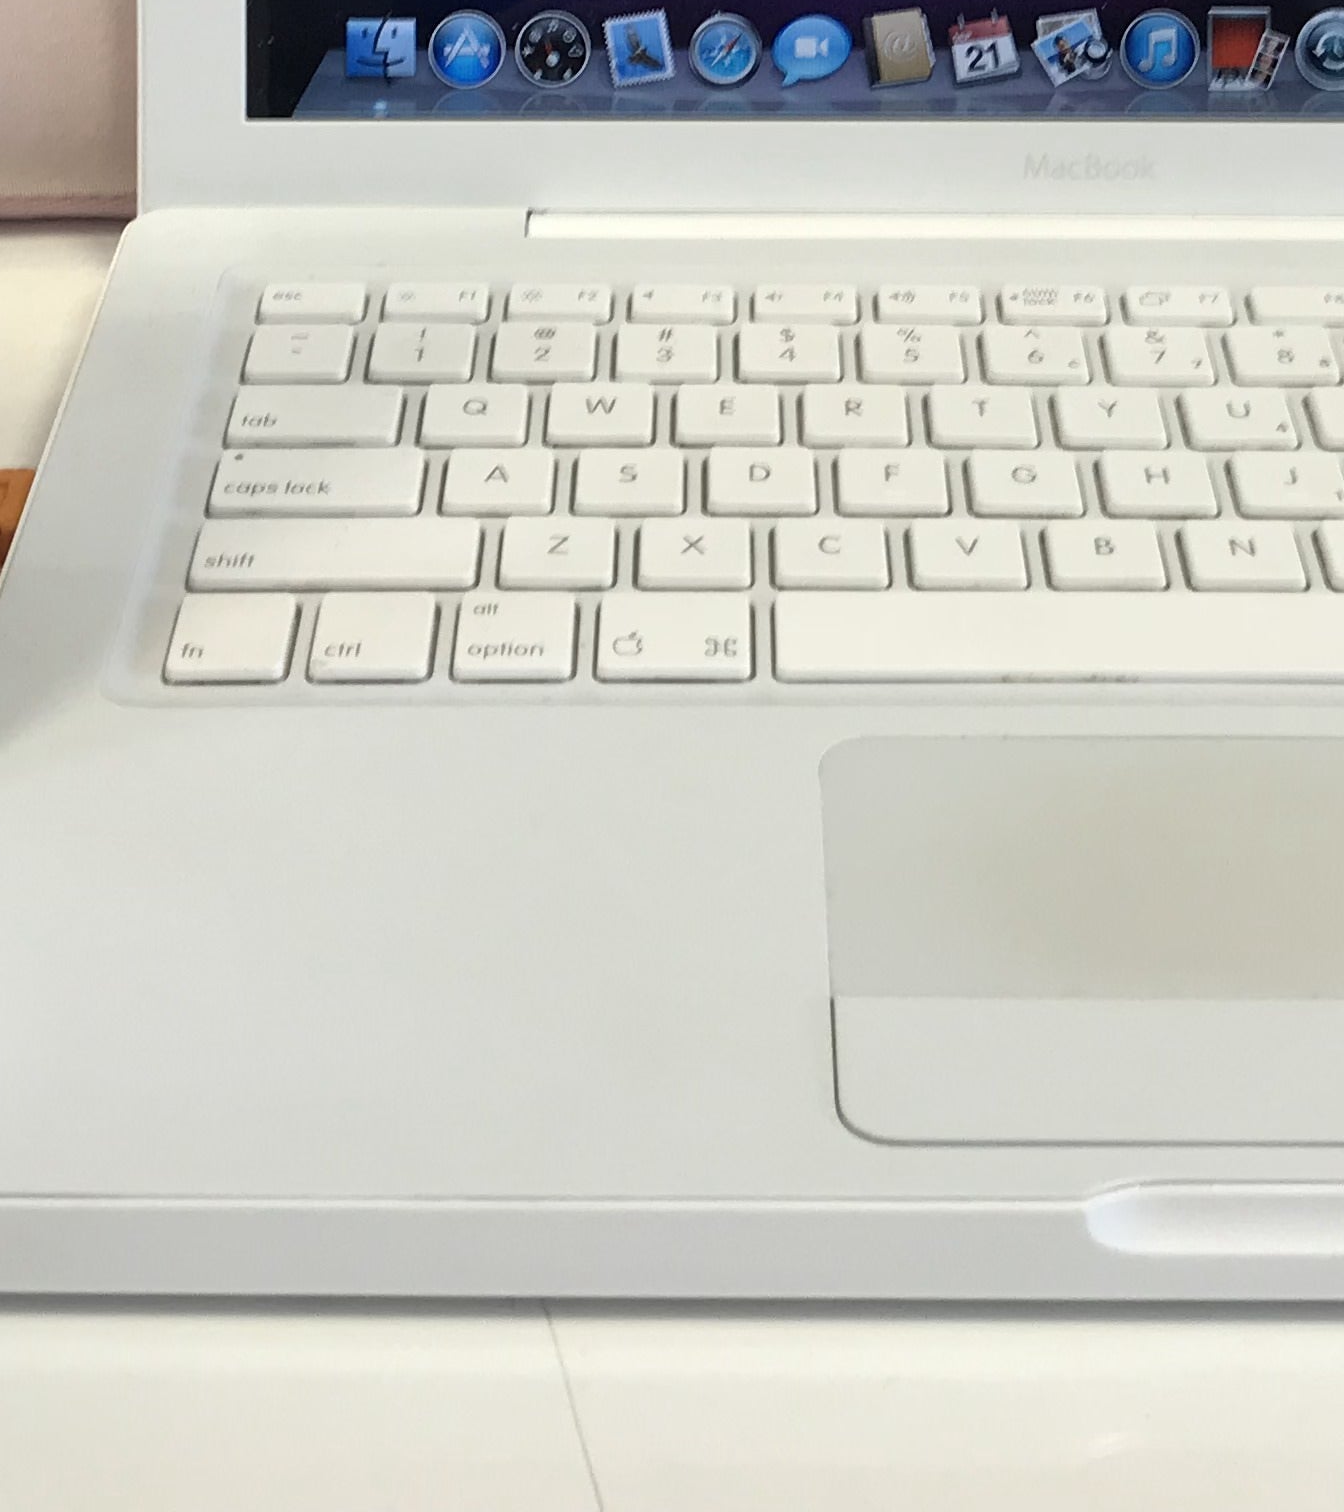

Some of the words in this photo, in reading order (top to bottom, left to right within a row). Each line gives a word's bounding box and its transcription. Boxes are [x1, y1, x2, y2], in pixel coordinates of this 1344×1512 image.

[965, 40, 1000, 72] 21
[1023, 152, 1158, 180] MacBook
[535, 347, 551, 361] 2
[657, 347, 674, 362] 3
[779, 347, 796, 362] 4
[904, 348, 919, 362] 5
[1028, 349, 1044, 364] 6
[1155, 350, 1166, 364] 7
[1277, 349, 1295, 363] 8
[463, 399, 488, 415] Q
[586, 398, 616, 414] W
[719, 399, 732, 415] E
[845, 399, 862, 416] R
[973, 399, 987, 417] T
[1099, 401, 1117, 418] Y
[1226, 402, 1251, 418] U
[242, 413, 277, 427] tab
[485, 465, 508, 483] A
[620, 465, 638, 483] S
[749, 464, 771, 481] D
[884, 464, 898, 482] F
[1011, 467, 1037, 483] G
[1144, 467, 1170, 484] H
[1287, 468, 1298, 485] J
[224, 483, 278, 497] caps
[284, 480, 328, 494] lock
[548, 536, 569, 554] Z
[681, 536, 704, 555] X
[818, 536, 840, 554] C
[956, 538, 978, 556] V
[1094, 537, 1115, 555] B
[1229, 539, 1256, 557] N
[204, 553, 254, 568] shift
[473, 603, 498, 615] alt
[182, 643, 203, 658] fn
[324, 643, 361, 657] ctrl
[467, 643, 544, 660] option
